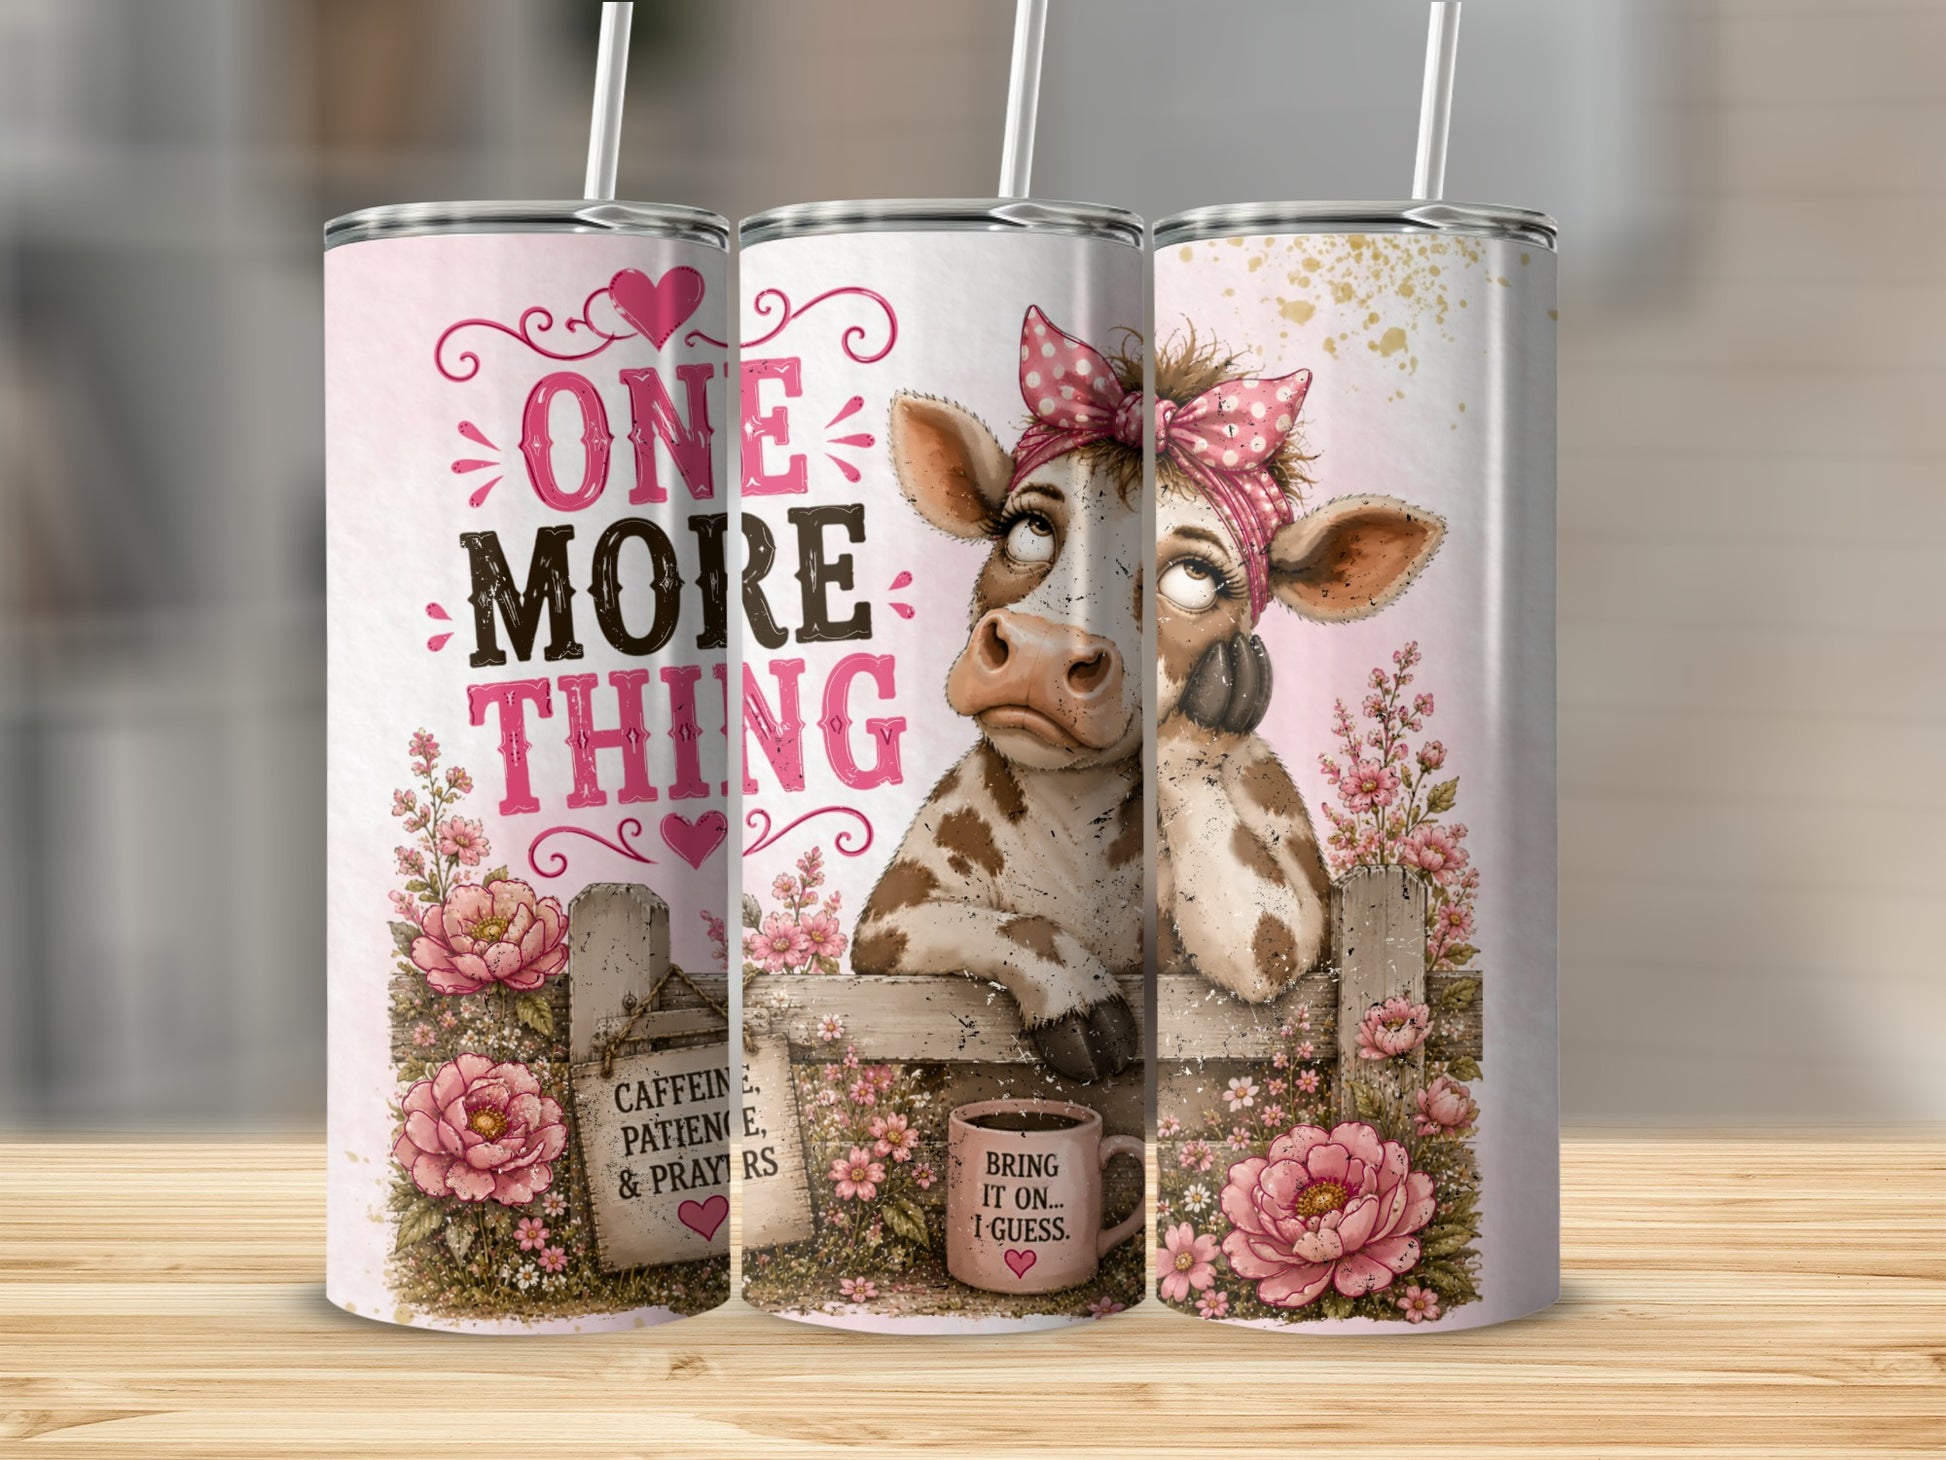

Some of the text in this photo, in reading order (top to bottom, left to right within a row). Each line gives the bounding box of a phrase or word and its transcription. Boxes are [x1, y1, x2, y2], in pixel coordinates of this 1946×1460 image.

[518, 357, 808, 512] ONE
[459, 503, 873, 668] MORE
[466, 652, 907, 816] THING
[986, 1151, 1060, 1178] BRING
[618, 1169, 641, 1200] &
[982, 1184, 1064, 1210] IT ON...
[974, 1214, 1071, 1242] I GUESS.
